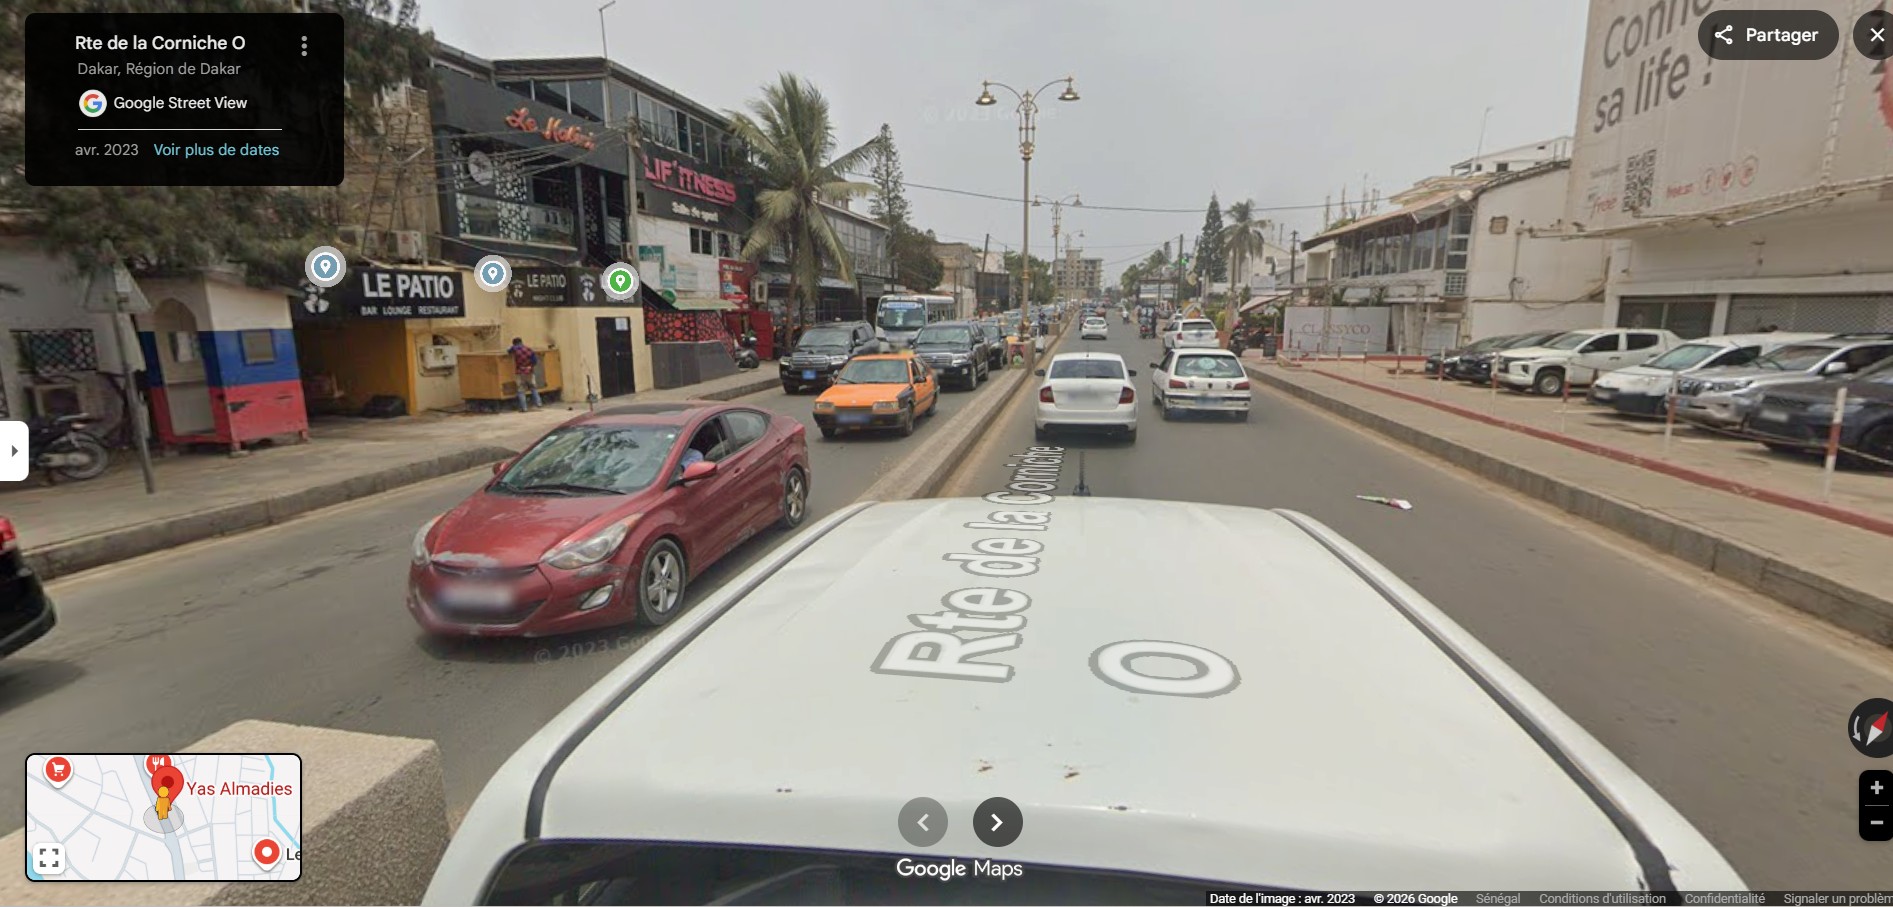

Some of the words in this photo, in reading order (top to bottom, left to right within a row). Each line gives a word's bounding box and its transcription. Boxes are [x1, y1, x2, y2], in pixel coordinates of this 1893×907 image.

[1593, 87, 1625, 133] sa
[1634, 46, 1690, 115] life
[1702, 23, 1719, 87] !
[361, 272, 393, 299] LE
[395, 275, 455, 299] PATIO
[526, 274, 540, 288] LE
[540, 274, 567, 289] PATIO
[361, 306, 378, 316] BAR
[382, 305, 413, 316] LOUNGE
[418, 305, 459, 315] RESTAURANT
[1301, 322, 1371, 335] CLSSYCO
